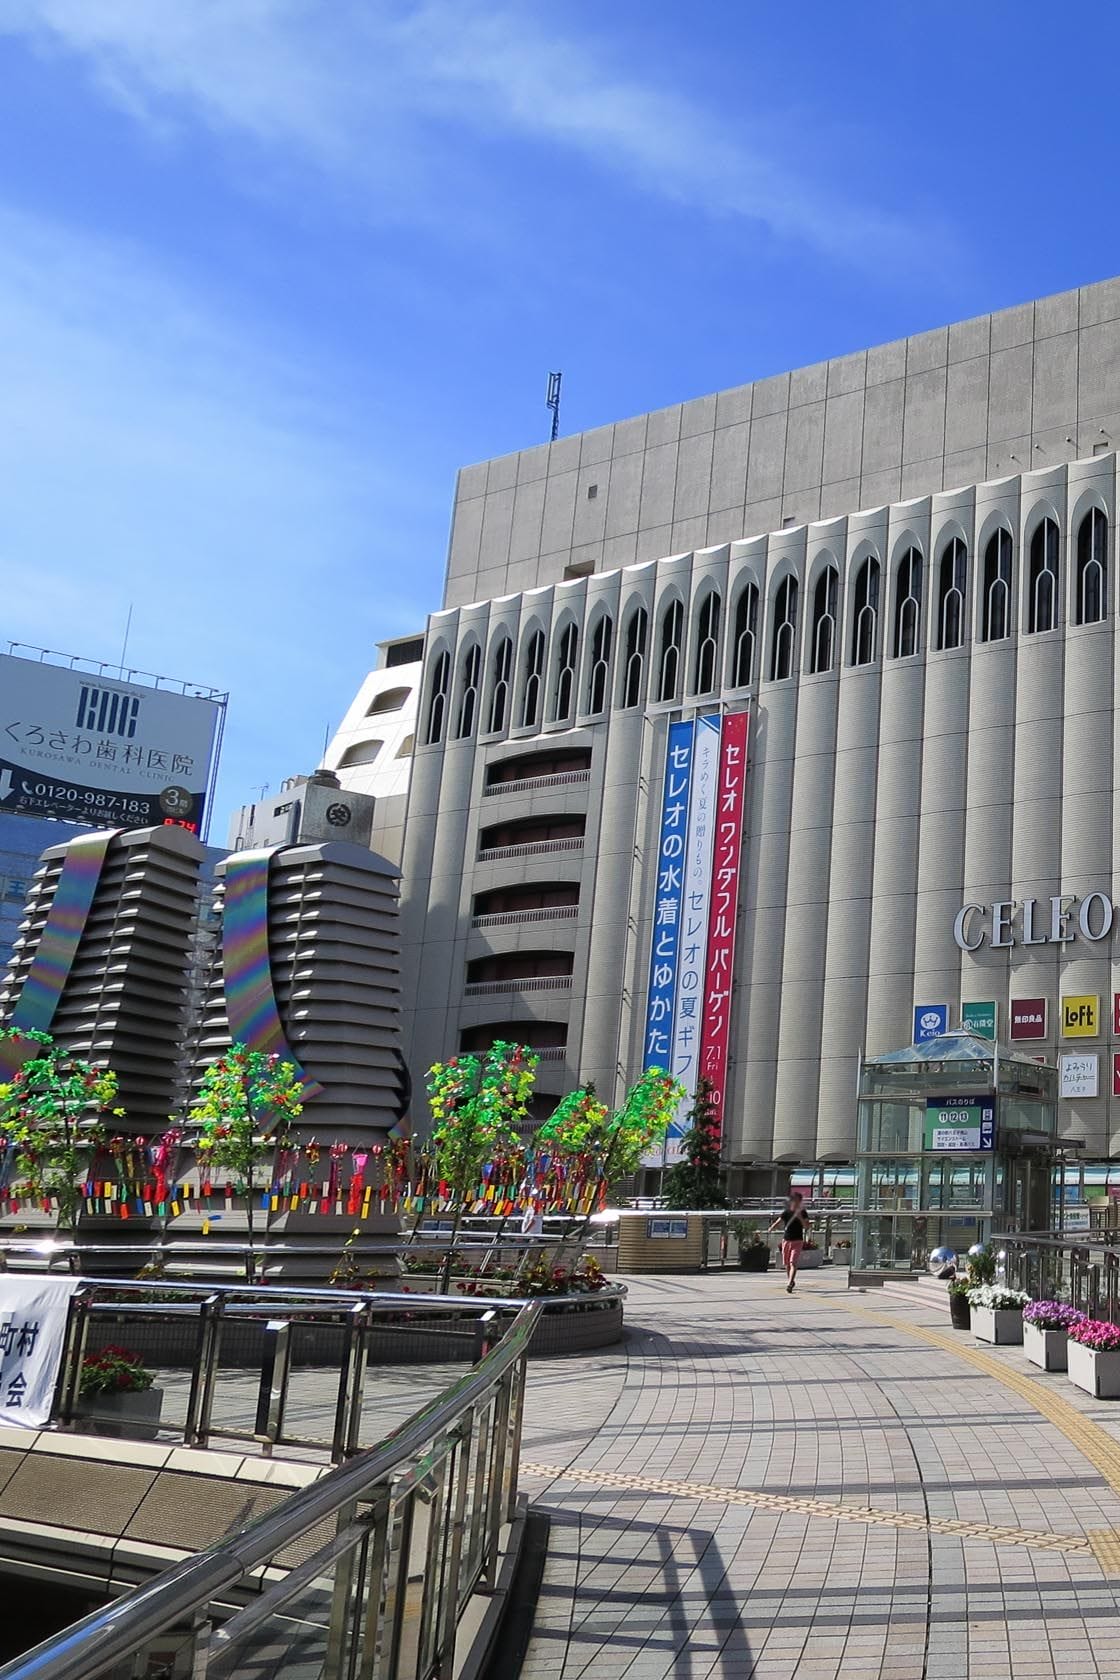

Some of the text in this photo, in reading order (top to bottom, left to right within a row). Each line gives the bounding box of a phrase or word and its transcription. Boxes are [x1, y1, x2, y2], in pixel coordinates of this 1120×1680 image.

[5, 721, 194, 776] くろさわ歯科医院
[20, 748, 175, 783] KUROSAWA DENTAL CLINIC
[35, 783, 151, 814] 0120-987-183
[648, 744, 691, 1054] セレオの水着とゆかた
[708, 743, 740, 1038] セレオ ワンダフル バーゲン
[953, 892, 1114, 951] CELEO
[920, 1029, 941, 1038] Keio
[705, 1046, 721, 1060] 7.1
[707, 1061, 718, 1070] Fri
[945, 1098, 976, 1106] バスのりば
